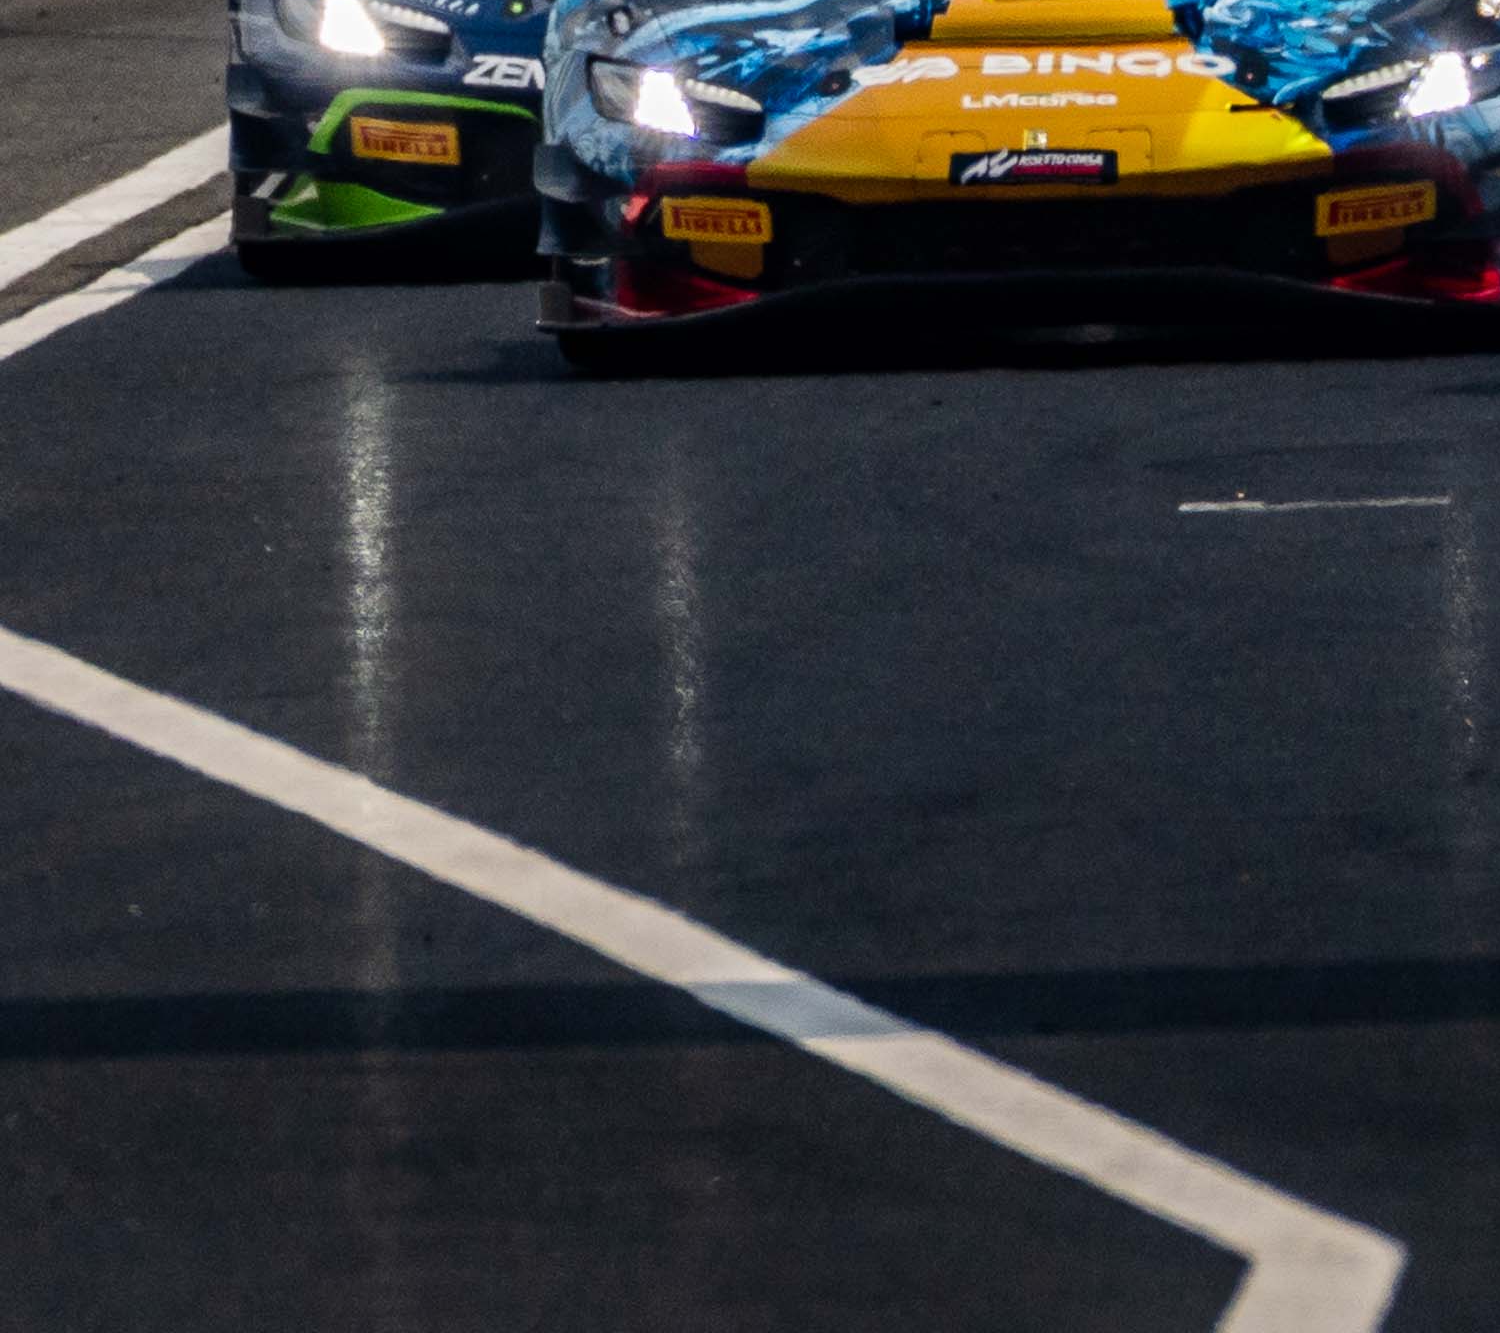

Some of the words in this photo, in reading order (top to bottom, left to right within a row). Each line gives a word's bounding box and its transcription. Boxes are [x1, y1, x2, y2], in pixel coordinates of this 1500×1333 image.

[360, 125, 450, 157] PIRELLI
[672, 207, 765, 236] PIRELLI
[1328, 188, 1427, 228] PIRELLI
